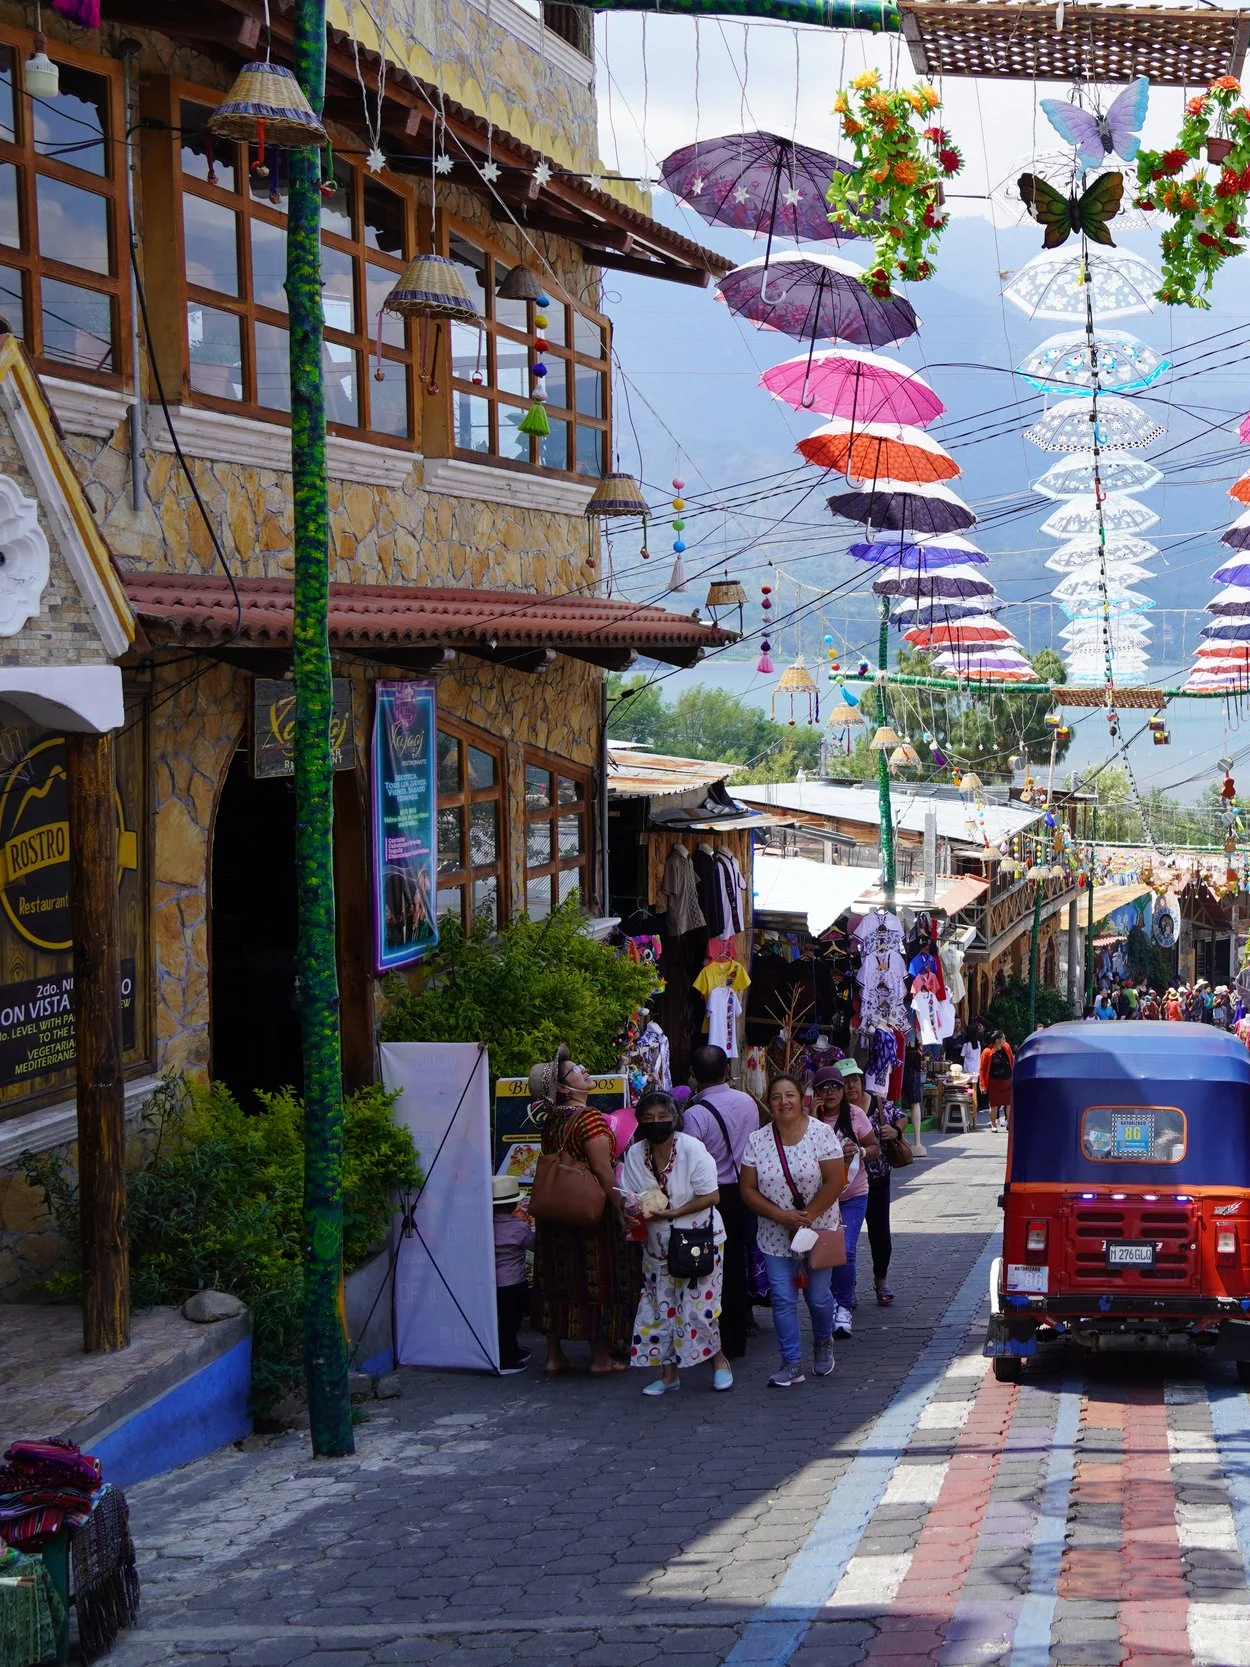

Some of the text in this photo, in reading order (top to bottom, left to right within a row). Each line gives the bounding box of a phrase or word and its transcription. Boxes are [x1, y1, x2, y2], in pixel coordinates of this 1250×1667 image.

[10, 827, 65, 872] ROSTRO
[18, 892, 69, 916] Restaurant
[36, 983, 60, 998] 2do.
[1, 994, 70, 1026] ON VISTA
[12, 1024, 38, 1039] LEVEL
[39, 1015, 62, 1031] WITH
[38, 1031, 51, 1044] TO
[53, 1026, 72, 1040] THE
[27, 1038, 76, 1061] VEGETARIA
[15, 1048, 77, 1075] MEDITERRANE
[1125, 1126, 1141, 1140] 86
[1110, 1248, 1117, 1260] M
[1025, 1272, 1043, 1287] 86
